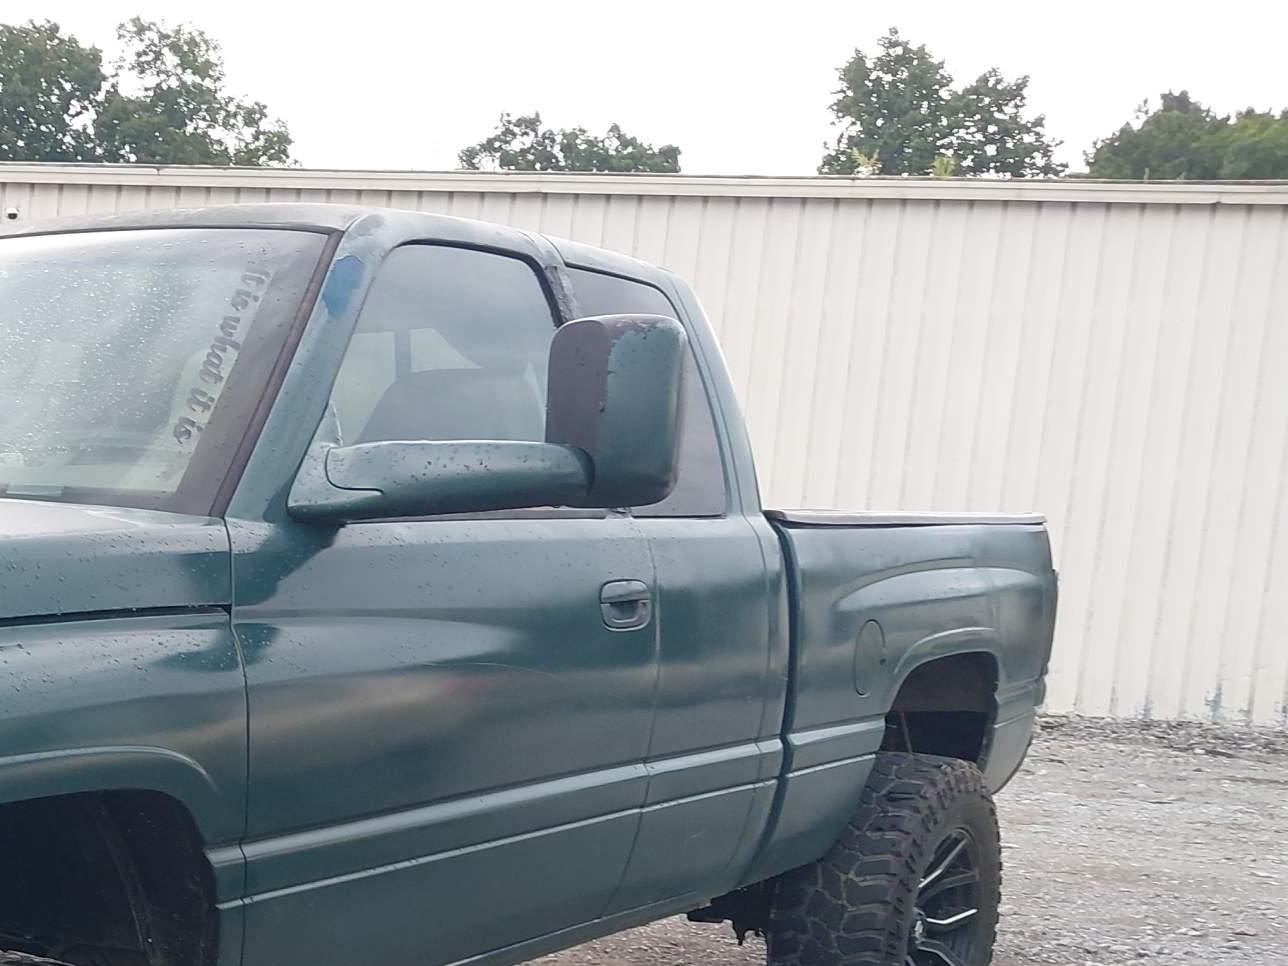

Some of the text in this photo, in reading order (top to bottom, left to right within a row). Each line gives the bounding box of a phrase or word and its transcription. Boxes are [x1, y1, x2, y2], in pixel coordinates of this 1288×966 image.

[231, 288, 260, 311] is
[200, 316, 241, 385] what
[186, 387, 215, 414] it
[172, 416, 204, 445] is
